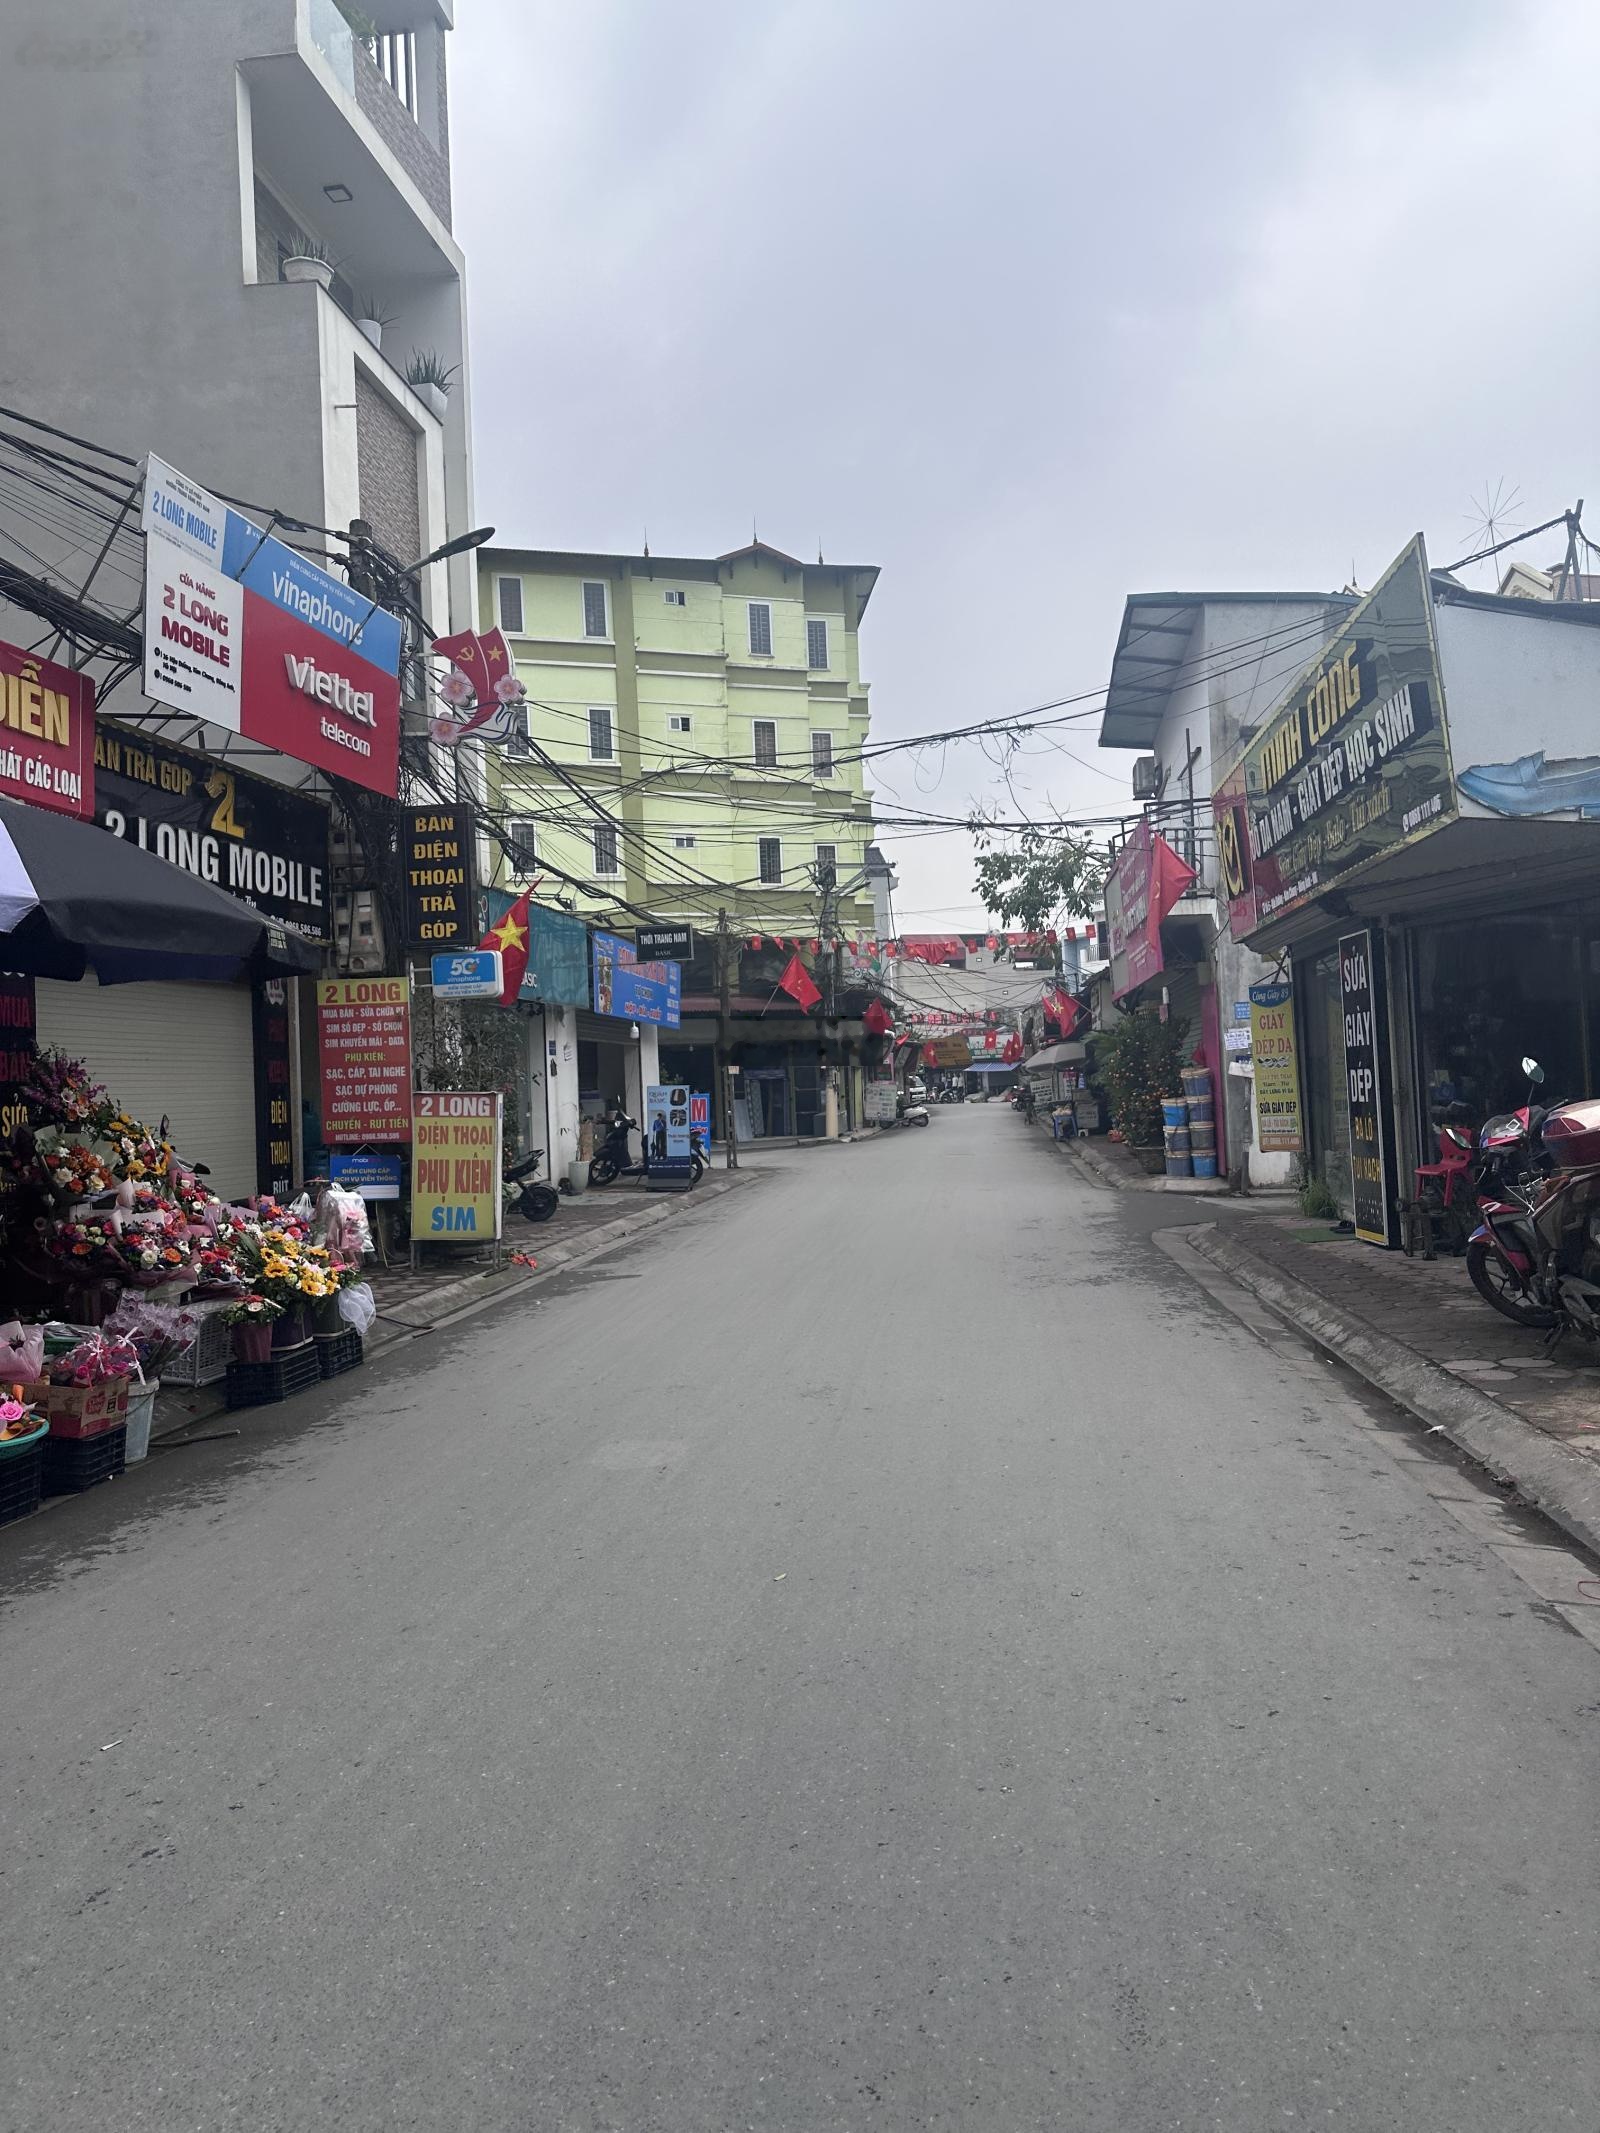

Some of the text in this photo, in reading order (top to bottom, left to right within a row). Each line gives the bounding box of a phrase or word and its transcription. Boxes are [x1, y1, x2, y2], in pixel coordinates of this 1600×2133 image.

[153, 490, 160, 513] 2
[160, 495, 185, 529] LONG
[186, 511, 217, 550] MOBILE
[163, 583, 229, 637] 2 LONG
[272, 570, 363, 645] vinaphone
[161, 615, 230, 668] MOBILE
[284, 653, 377, 728] viettel
[321, 717, 370, 757] telecom
[25, 754, 51, 790] CÁC
[54, 766, 82, 803] LOẠI
[1259, 814, 1273, 853] DA
[1271, 794, 1294, 844] NAM
[1298, 766, 1322, 822] GIÀY
[1345, 721, 1374, 784] HỌC
[1374, 683, 1415, 758] SINH
[413, 839, 458, 862] ĐIỆN
[229, 843, 323, 907] MOBILE
[409, 868, 464, 889] THOẠI
[420, 890, 456, 913] TRẢ
[420, 919, 458, 939] GÓP
[673, 932, 687, 943] NAM
[1343, 946, 1368, 993] SỬA
[325, 982, 401, 1003] 2 LONG
[322, 1008, 338, 1018] MUA
[1259, 1009, 1285, 1031] GIÀY
[326, 1024, 339, 1033] SIM
[1345, 1005, 1371, 1048] GIÀY
[325, 1039, 338, 1048] SIM
[1255, 1034, 1275, 1055] DÉP
[1278, 1037, 1292, 1053] DA
[368, 1067, 381, 1078] TAI
[383, 1066, 406, 1077] NGHE
[1349, 1061, 1373, 1103] DÉP
[335, 1085, 353, 1098] SẠC
[420, 1096, 491, 1117] 2 LONG
[1260, 1097, 1297, 1114] SỬA GIÀY DÉP
[418, 1121, 493, 1150] ĐIỆN THOẠI
[270, 1141, 290, 1169] THOẠI
[417, 1152, 491, 1203] PHỤ KIỆN
[431, 1206, 476, 1232] SIM
